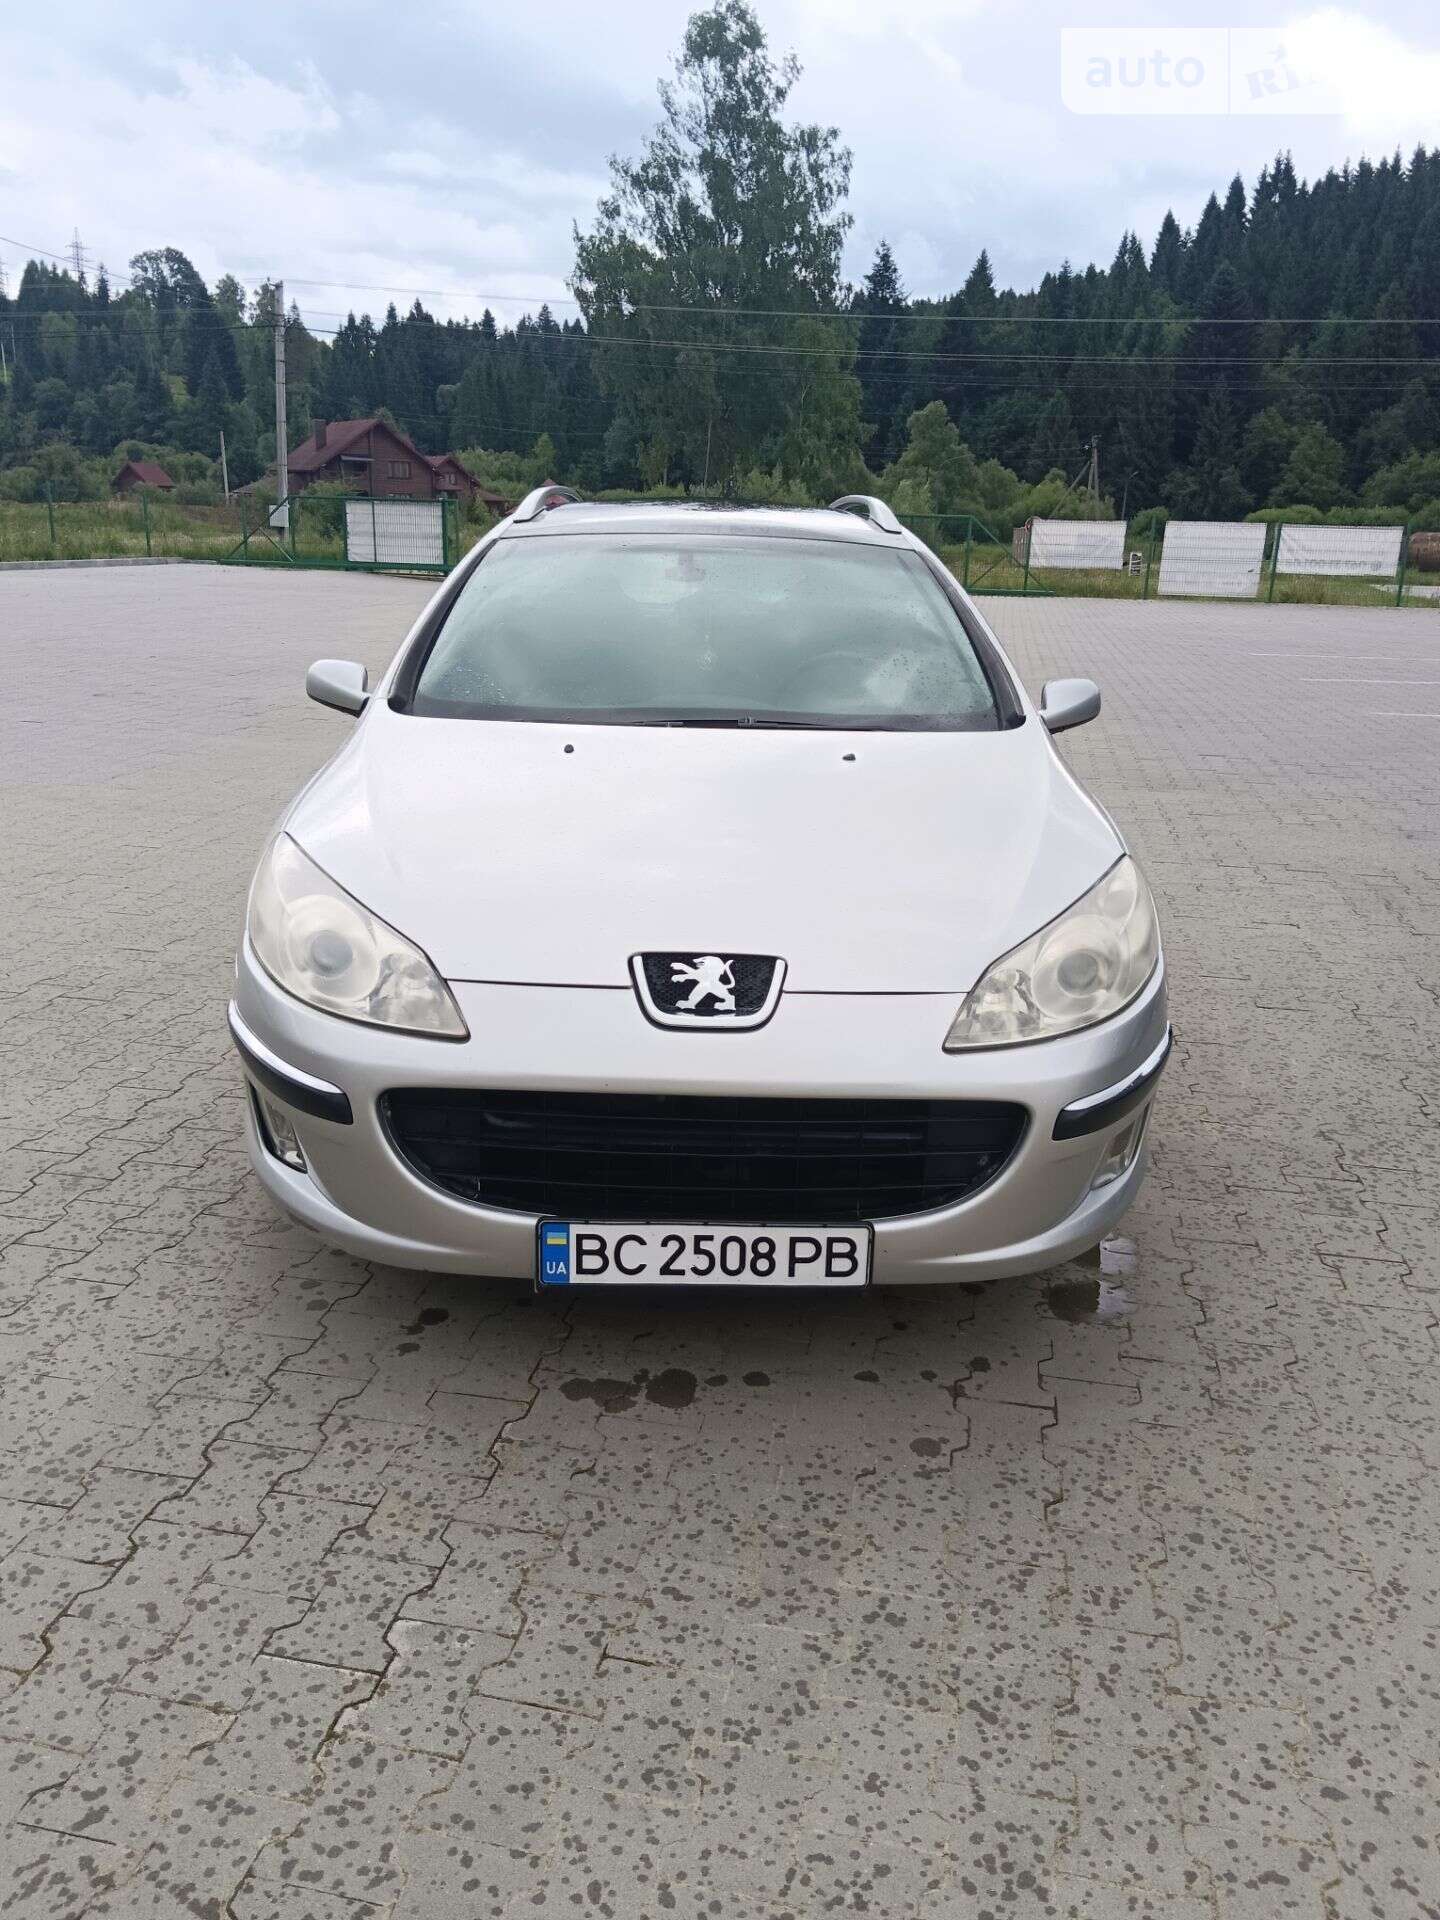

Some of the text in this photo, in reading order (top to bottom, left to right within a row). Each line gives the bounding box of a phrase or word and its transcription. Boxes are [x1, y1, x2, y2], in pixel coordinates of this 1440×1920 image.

[546, 1261, 567, 1275] UA
[575, 1233, 859, 1278] BC 2508 PB
